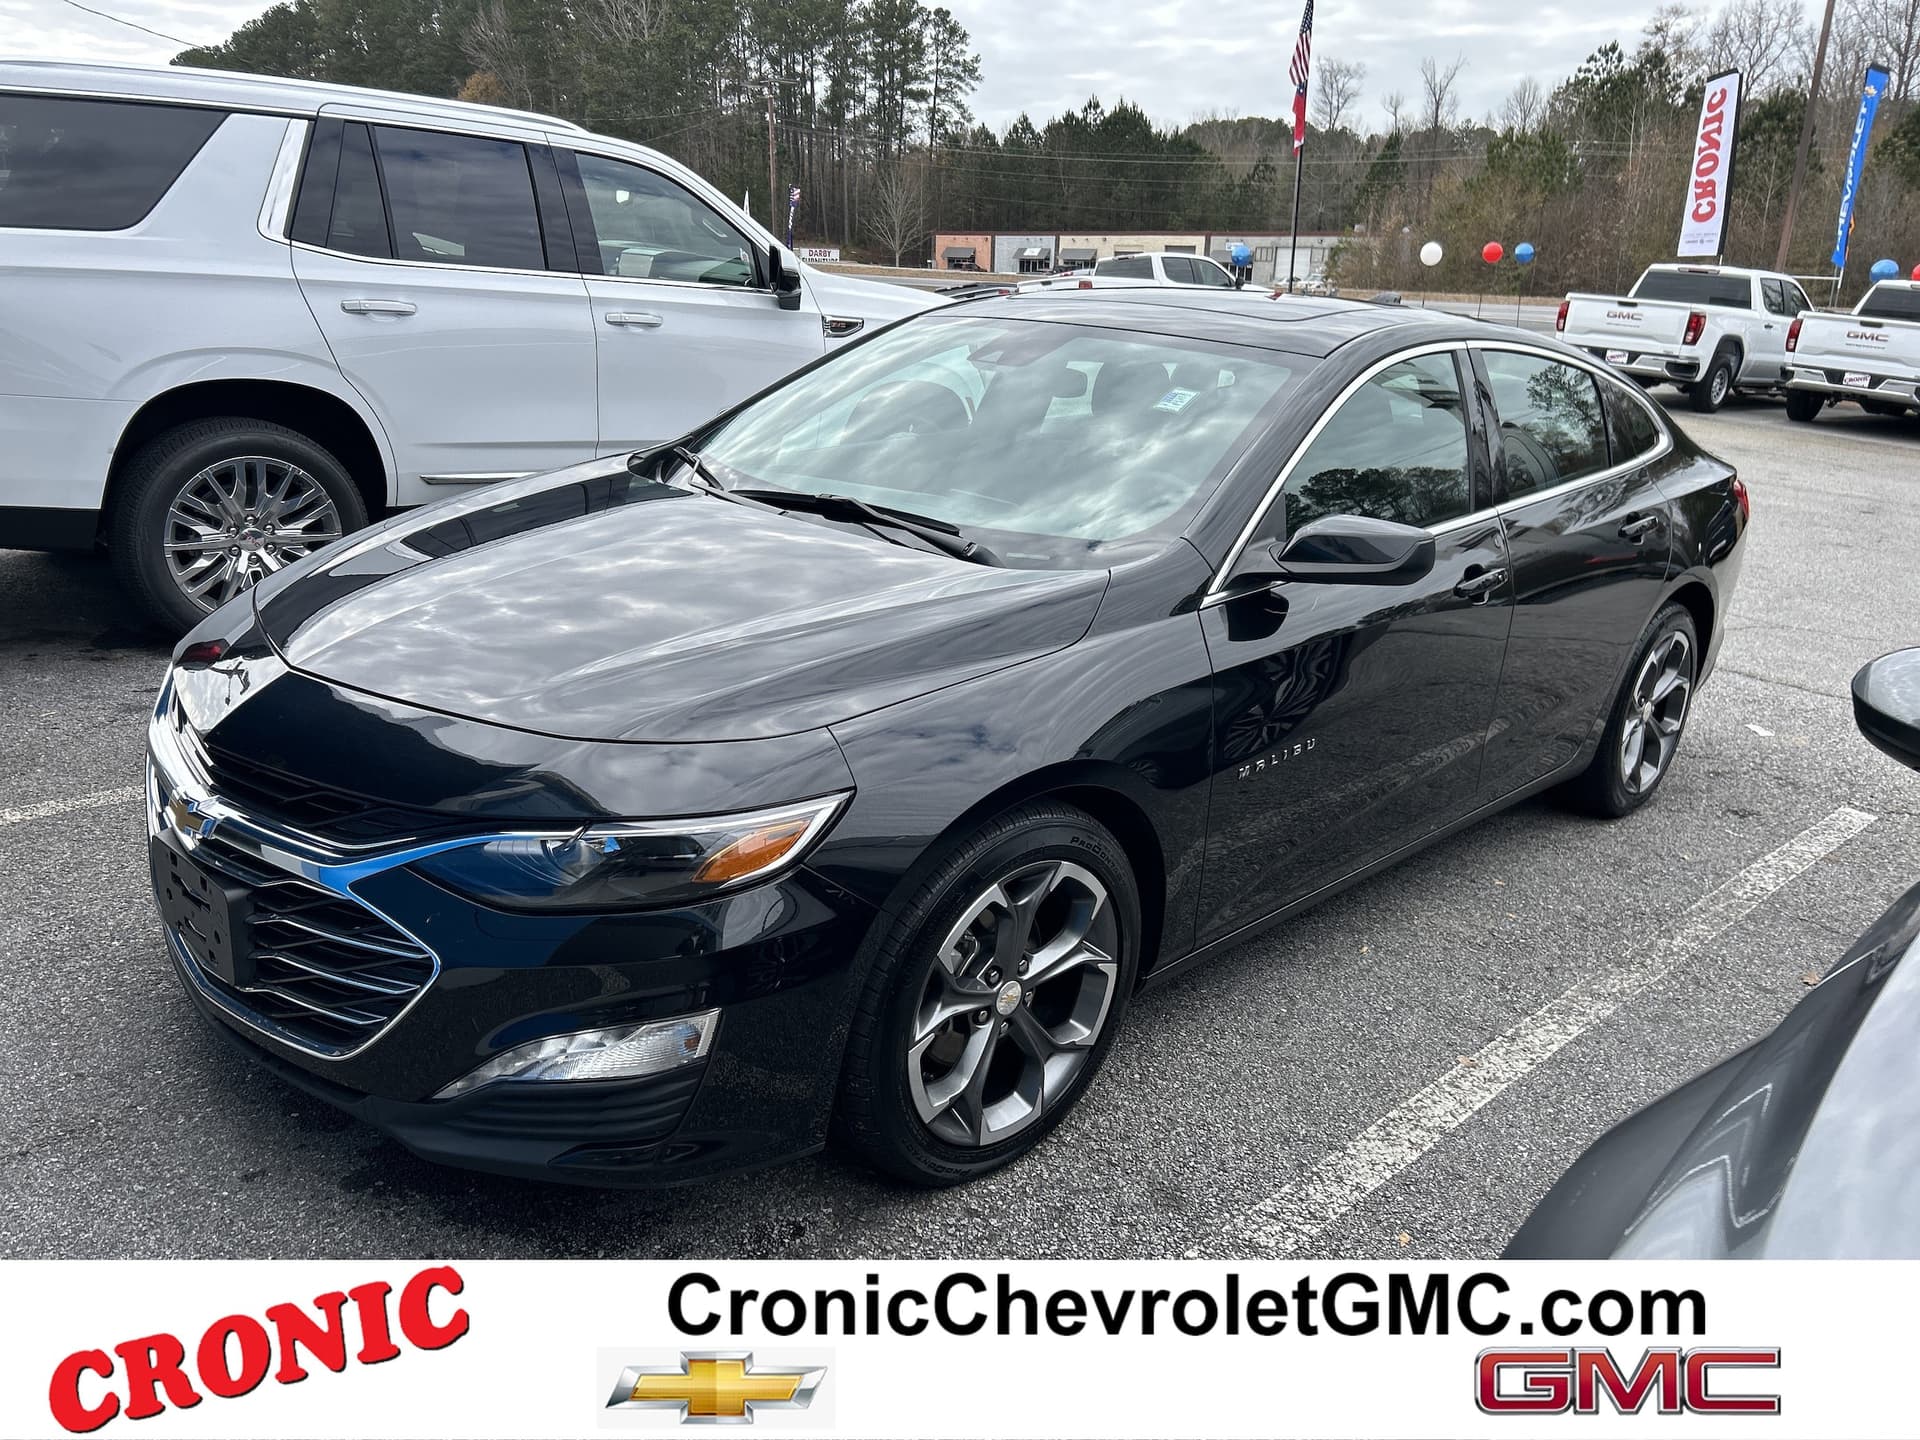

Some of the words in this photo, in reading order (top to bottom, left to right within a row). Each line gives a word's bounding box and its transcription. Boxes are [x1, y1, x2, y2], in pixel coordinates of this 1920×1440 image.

[808, 249, 832, 258] DARBY
[1606, 310, 1643, 321] GMC
[1846, 330, 1889, 342] GMC
[1238, 738, 1316, 780] MALIBU
